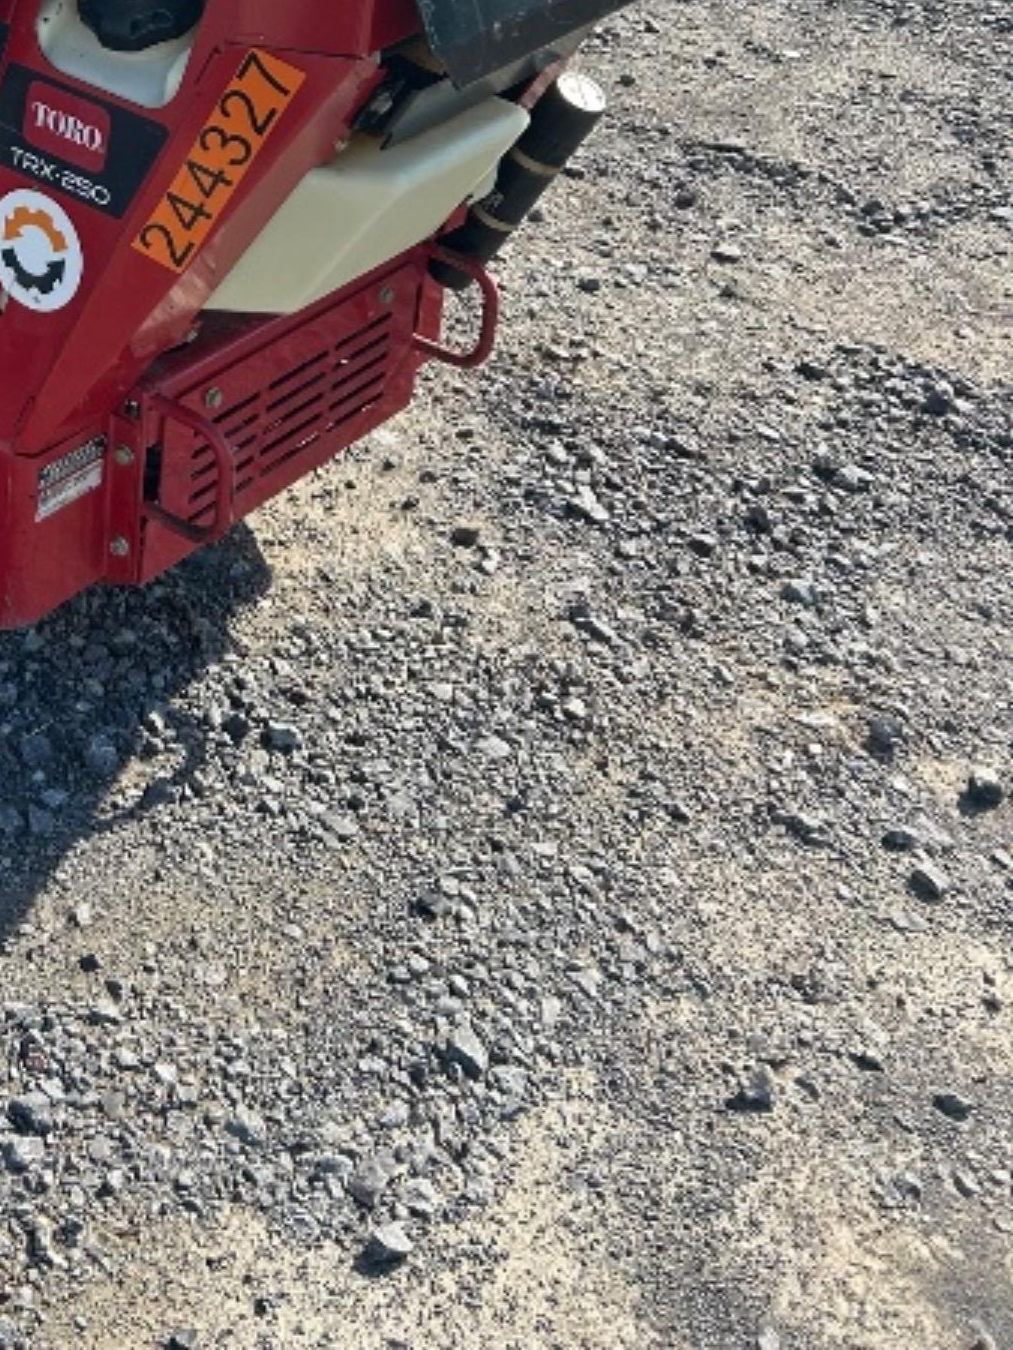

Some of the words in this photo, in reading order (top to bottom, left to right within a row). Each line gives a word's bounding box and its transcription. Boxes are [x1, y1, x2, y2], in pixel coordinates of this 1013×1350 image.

[31, 101, 105, 152] TORO
[9, 145, 112, 207] TRX-250
[139, 51, 292, 268] 244327
